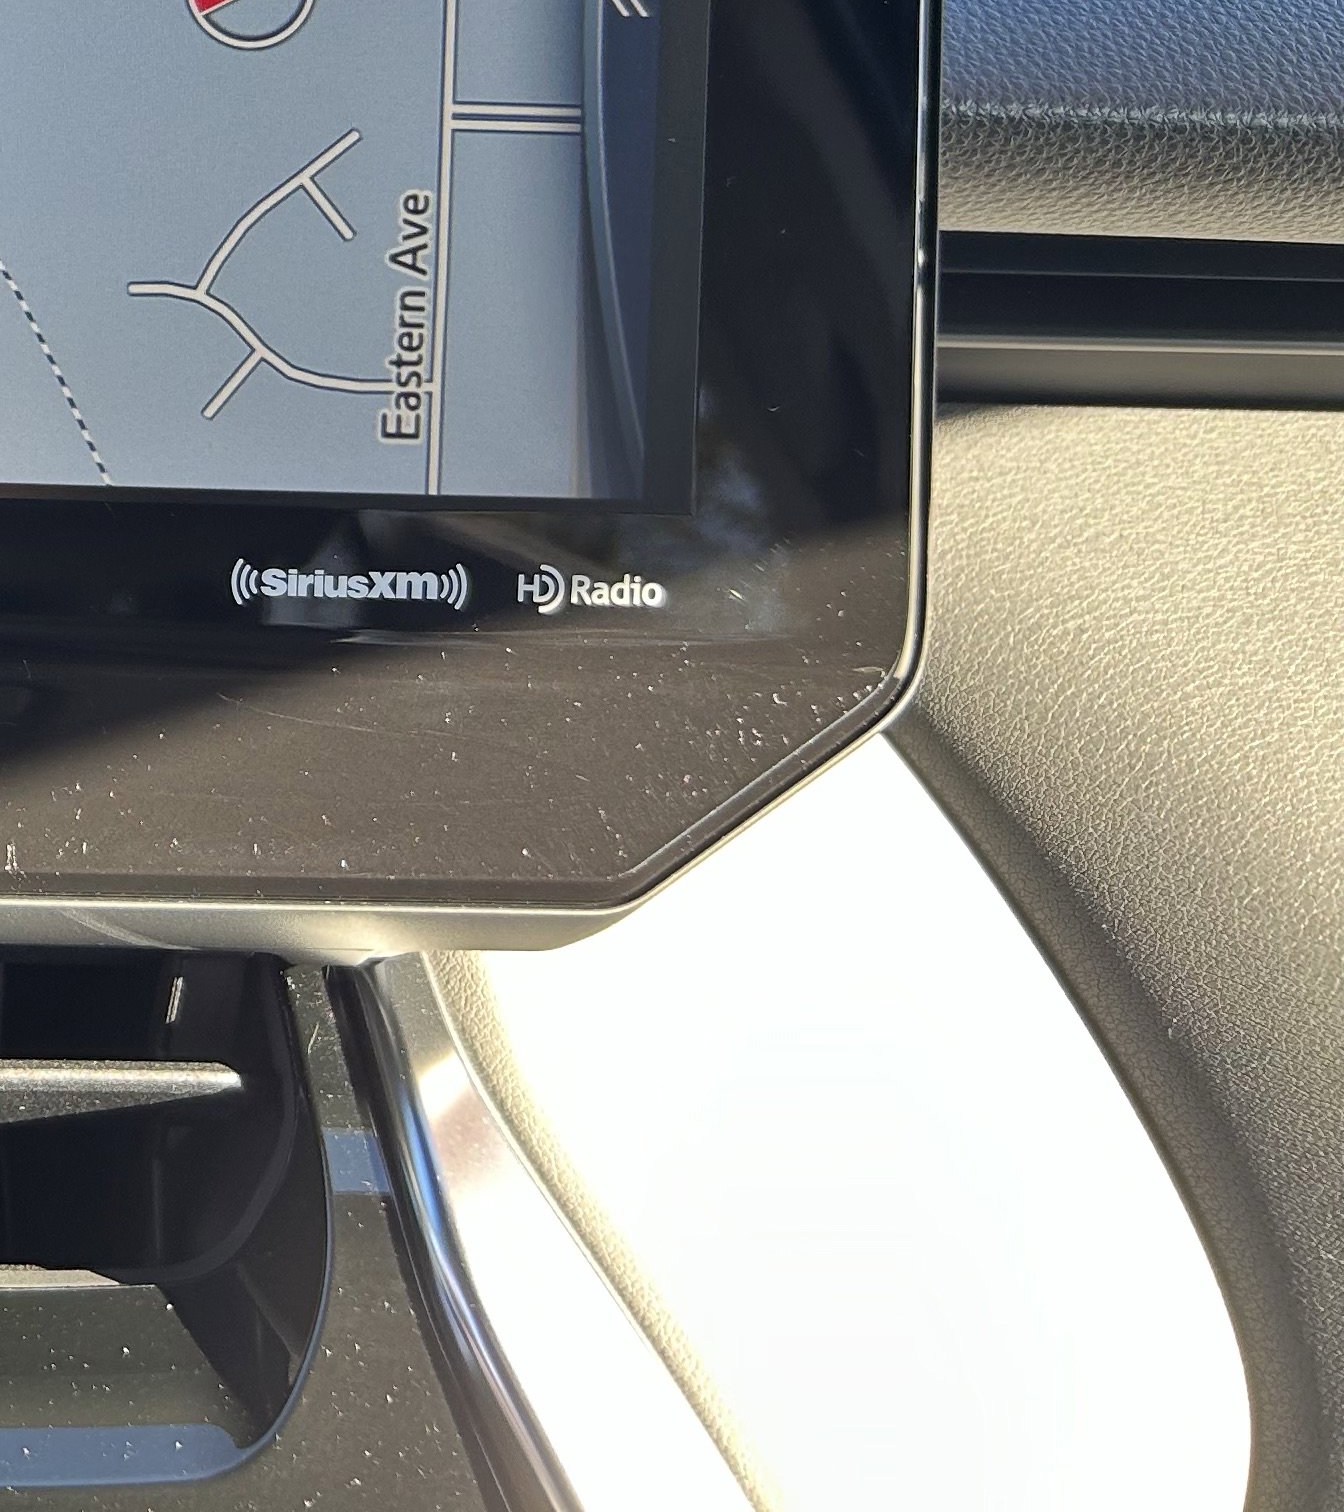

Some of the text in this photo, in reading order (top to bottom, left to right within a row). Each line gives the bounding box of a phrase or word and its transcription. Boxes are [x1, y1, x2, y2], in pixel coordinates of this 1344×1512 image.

[380, 191, 430, 441] Eastern Ave
[570, 573, 666, 608] Radio
